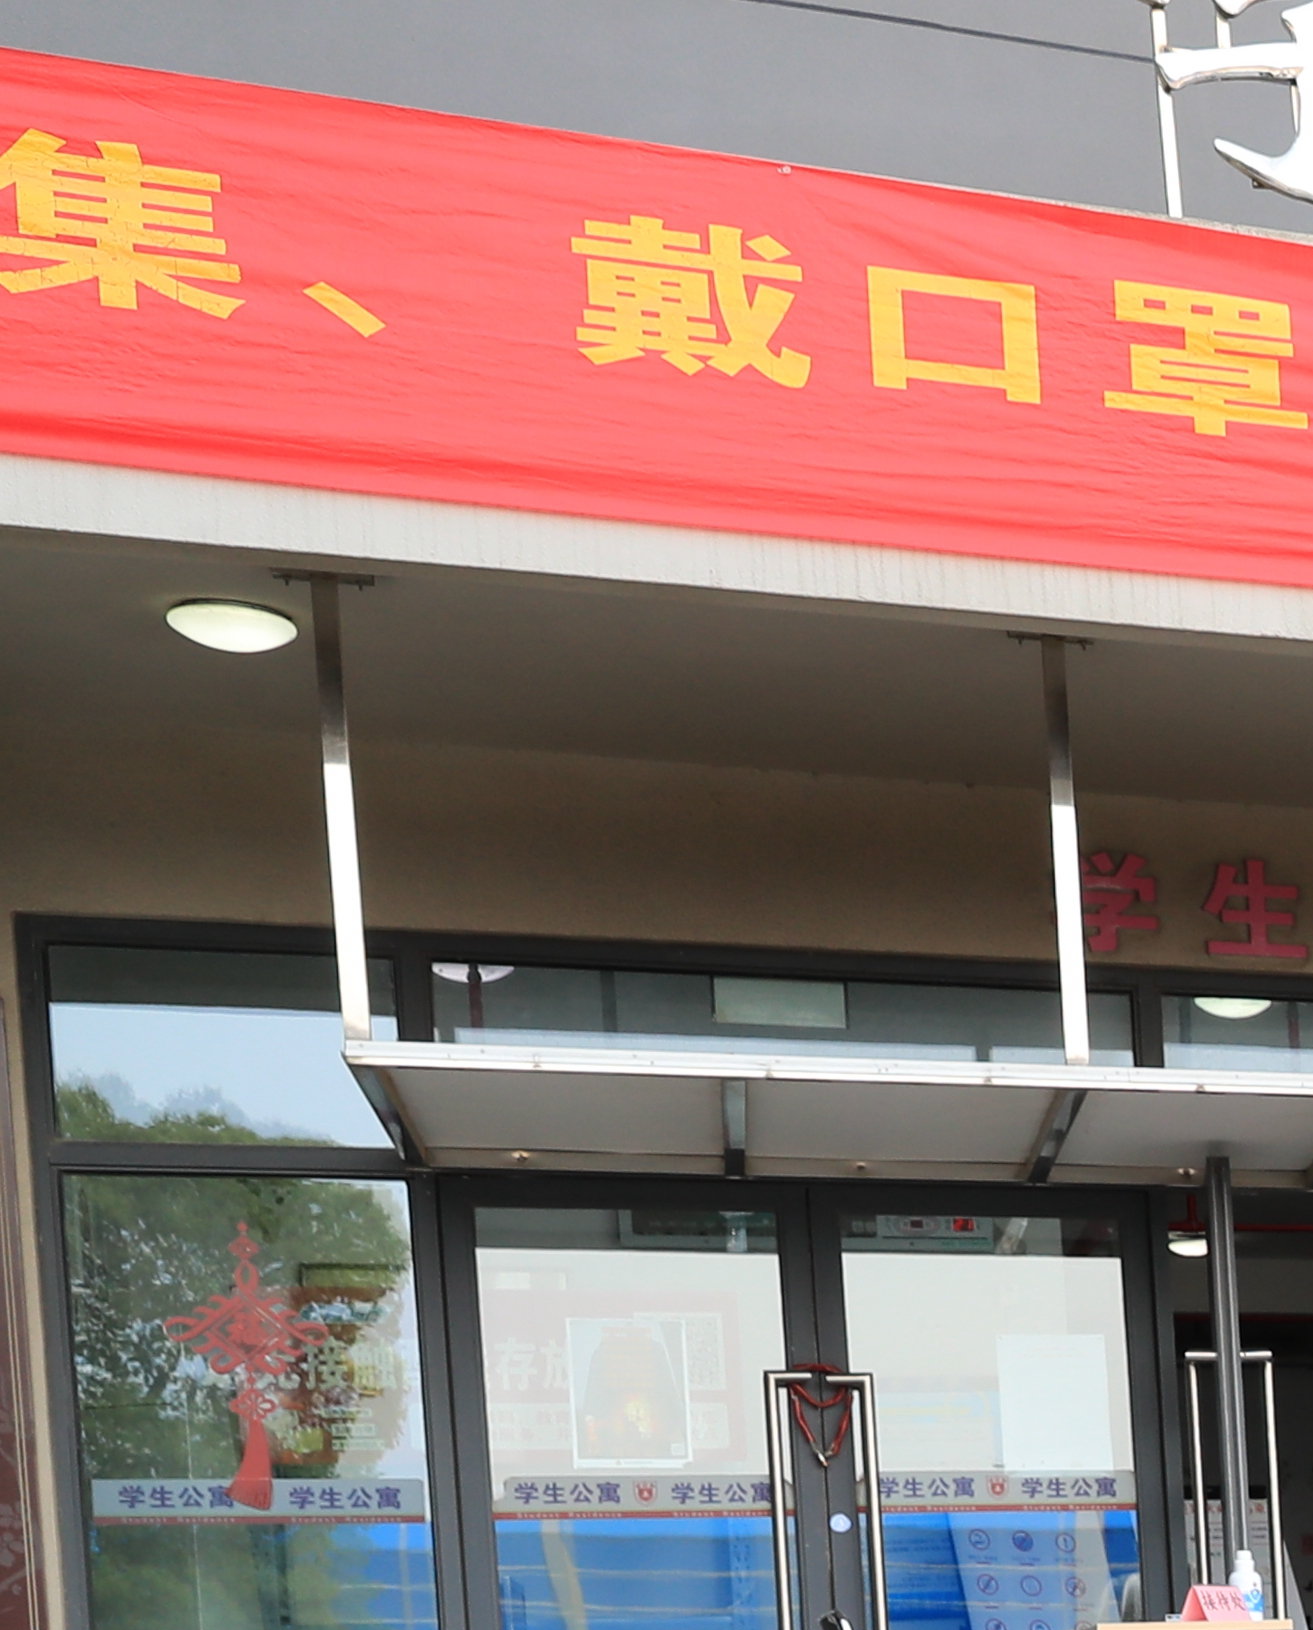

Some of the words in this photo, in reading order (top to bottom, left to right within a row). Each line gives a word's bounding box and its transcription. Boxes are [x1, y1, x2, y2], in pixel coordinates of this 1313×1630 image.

[117, 1485, 235, 1510] 学生公寓
[288, 1486, 401, 1510] 学生公寓
[513, 1481, 622, 1505] 学生公寓
[878, 1476, 976, 1500] 学生公寓
[1021, 1477, 1118, 1499] 学生公寓
